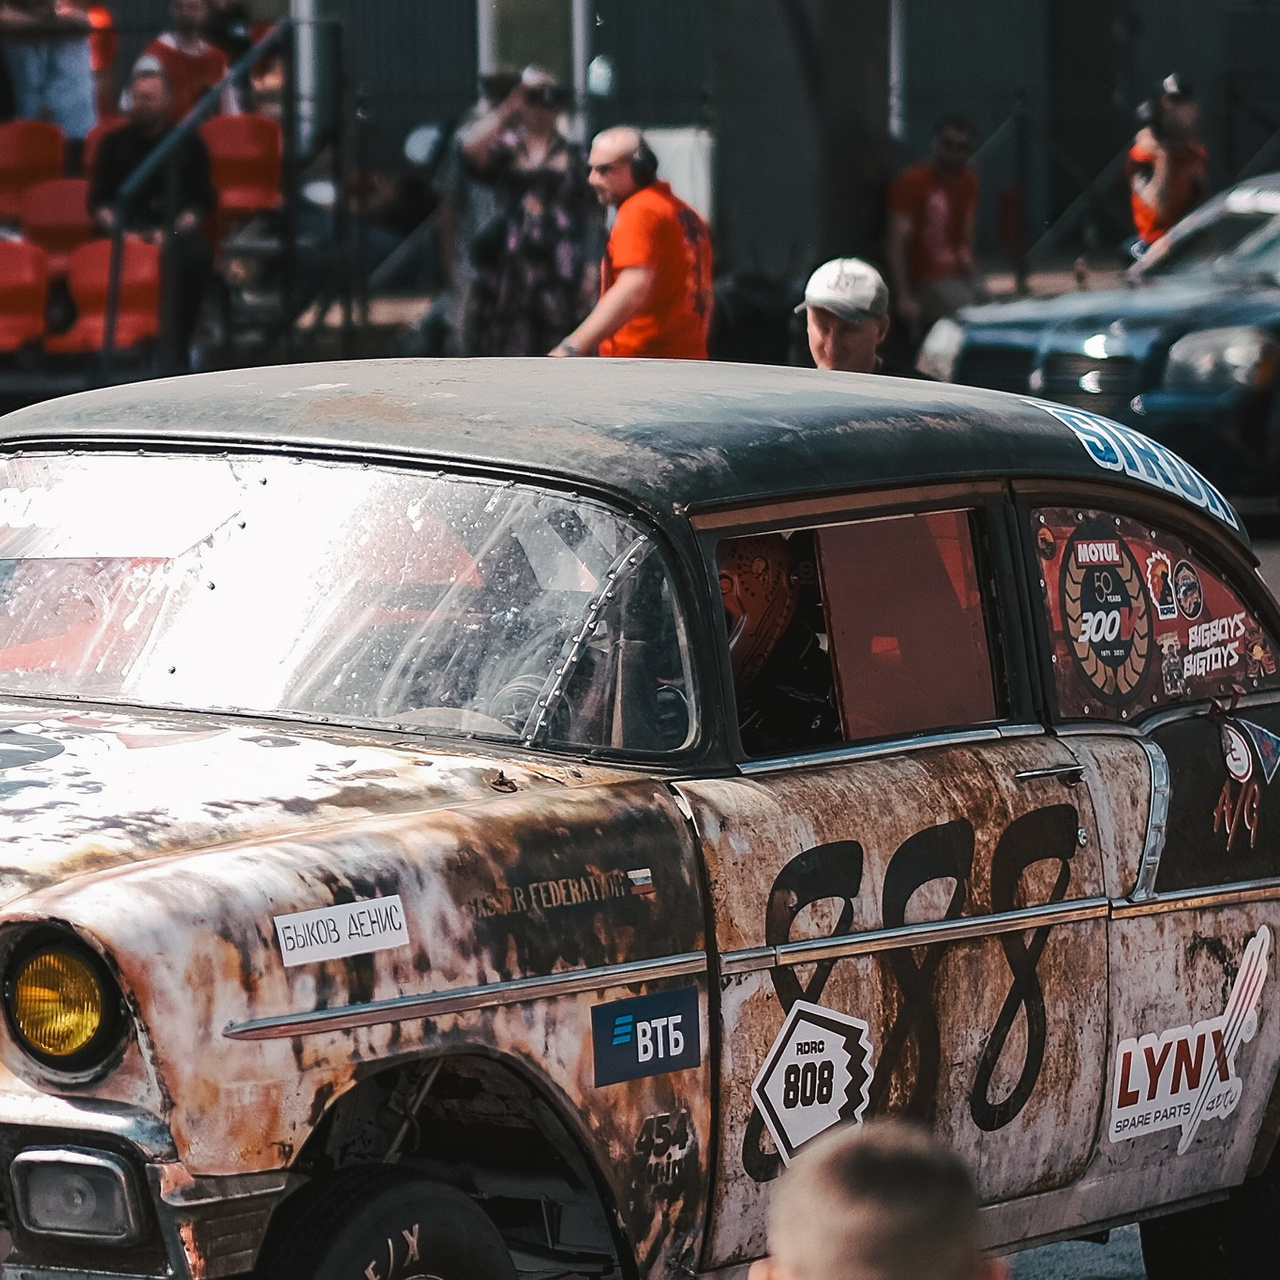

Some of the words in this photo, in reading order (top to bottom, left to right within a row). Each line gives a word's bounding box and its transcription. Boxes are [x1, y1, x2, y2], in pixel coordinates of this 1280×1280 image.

[1077, 543, 1120, 563] MOTUL
[1094, 572, 1113, 604] 50
[1107, 595, 1122, 603] YEARS
[1078, 607, 1141, 643] 300V
[1188, 611, 1246, 651] BIGBOYS
[1183, 640, 1240, 679] BIGTOYS
[281, 917, 340, 951] БЫКОВ
[347, 904, 402, 940] ДЕНИС
[636, 1014, 684, 1063] ВТБ
[795, 1039, 826, 1056] RDRC
[783, 1060, 835, 1110] 808
[1117, 1029, 1230, 1110] LYNX
[636, 1109, 689, 1158] 454
[1114, 1111, 1152, 1134] SPARE
[1153, 1101, 1191, 1123] PARTS
